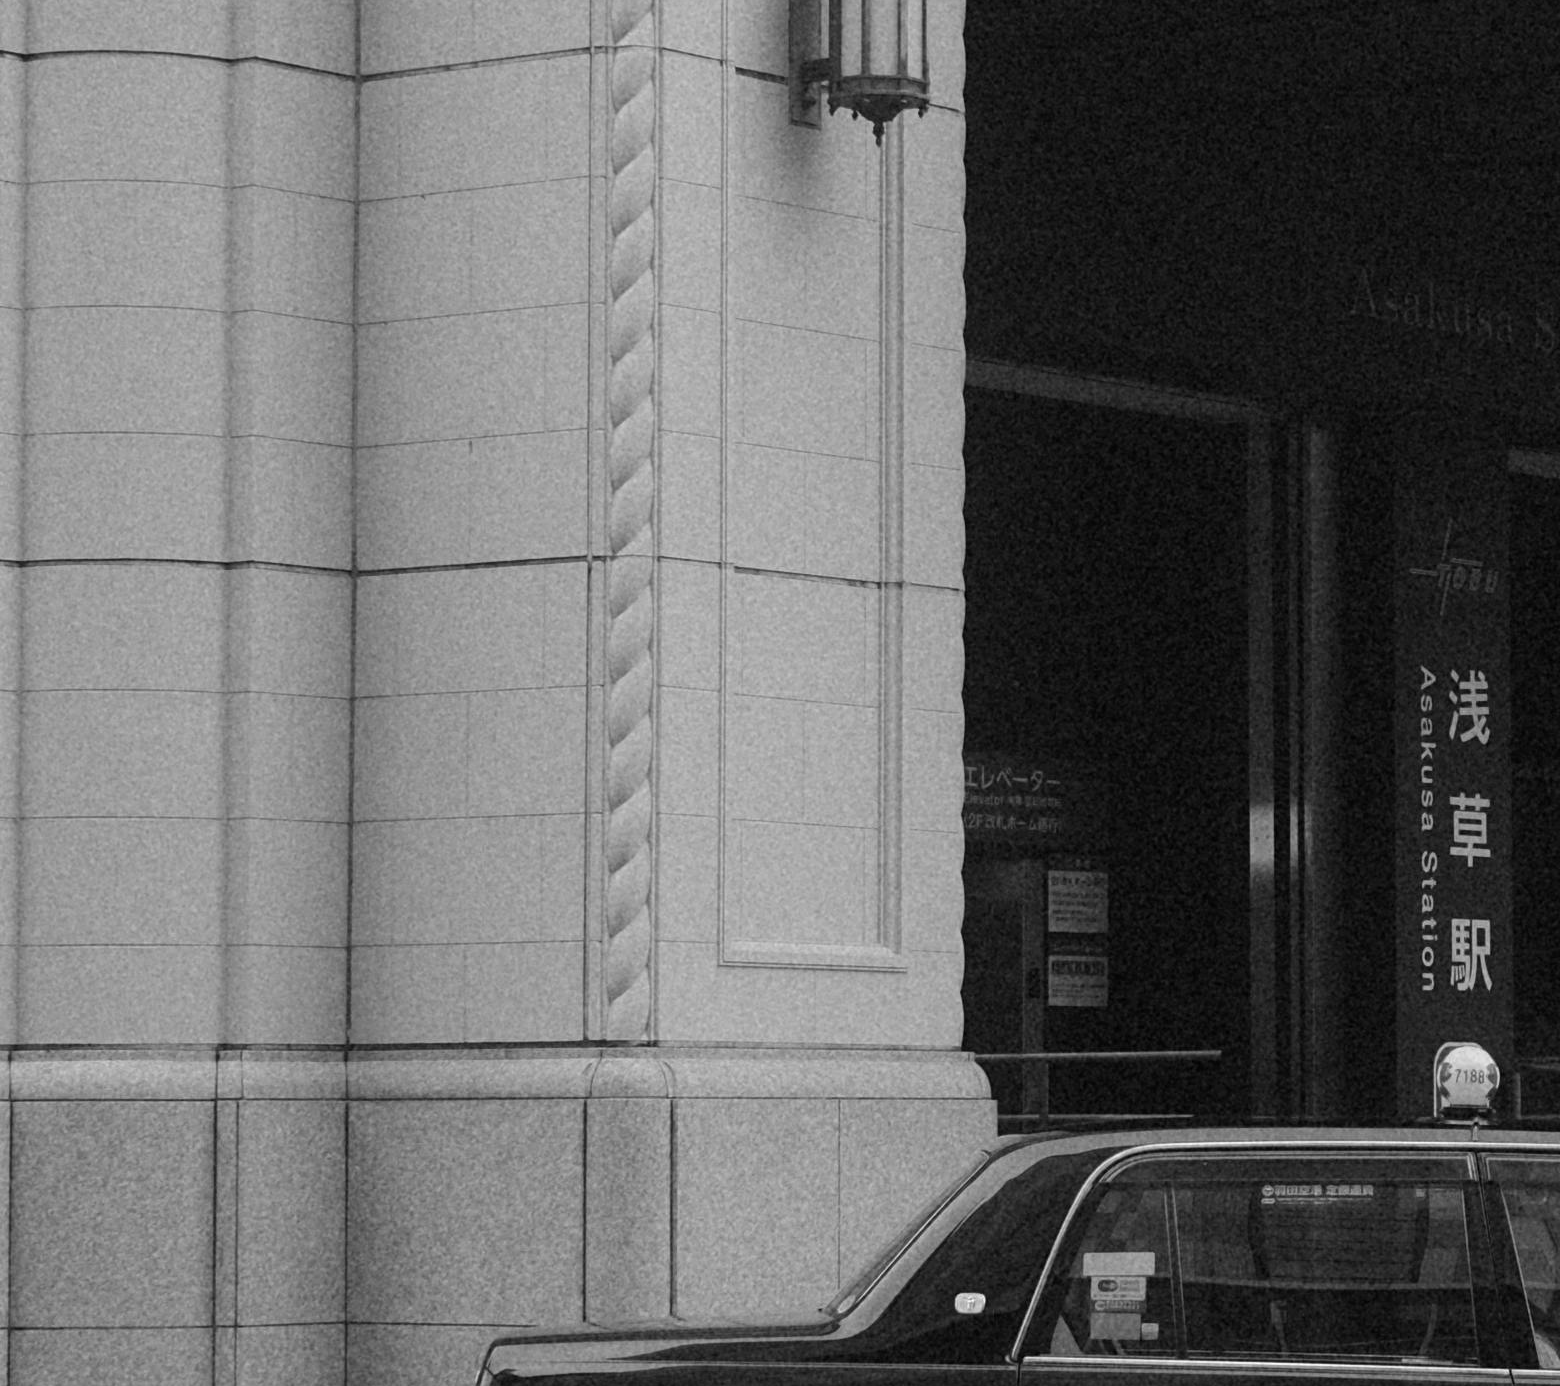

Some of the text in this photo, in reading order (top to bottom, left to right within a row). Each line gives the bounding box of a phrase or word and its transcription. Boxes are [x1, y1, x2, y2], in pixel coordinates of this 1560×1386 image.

[1437, 563, 1499, 593] TOBU
[1419, 665, 1439, 993] Asakusa Station
[1448, 669, 1492, 991] 浅草駅
[1453, 1067, 1486, 1086] 7188
